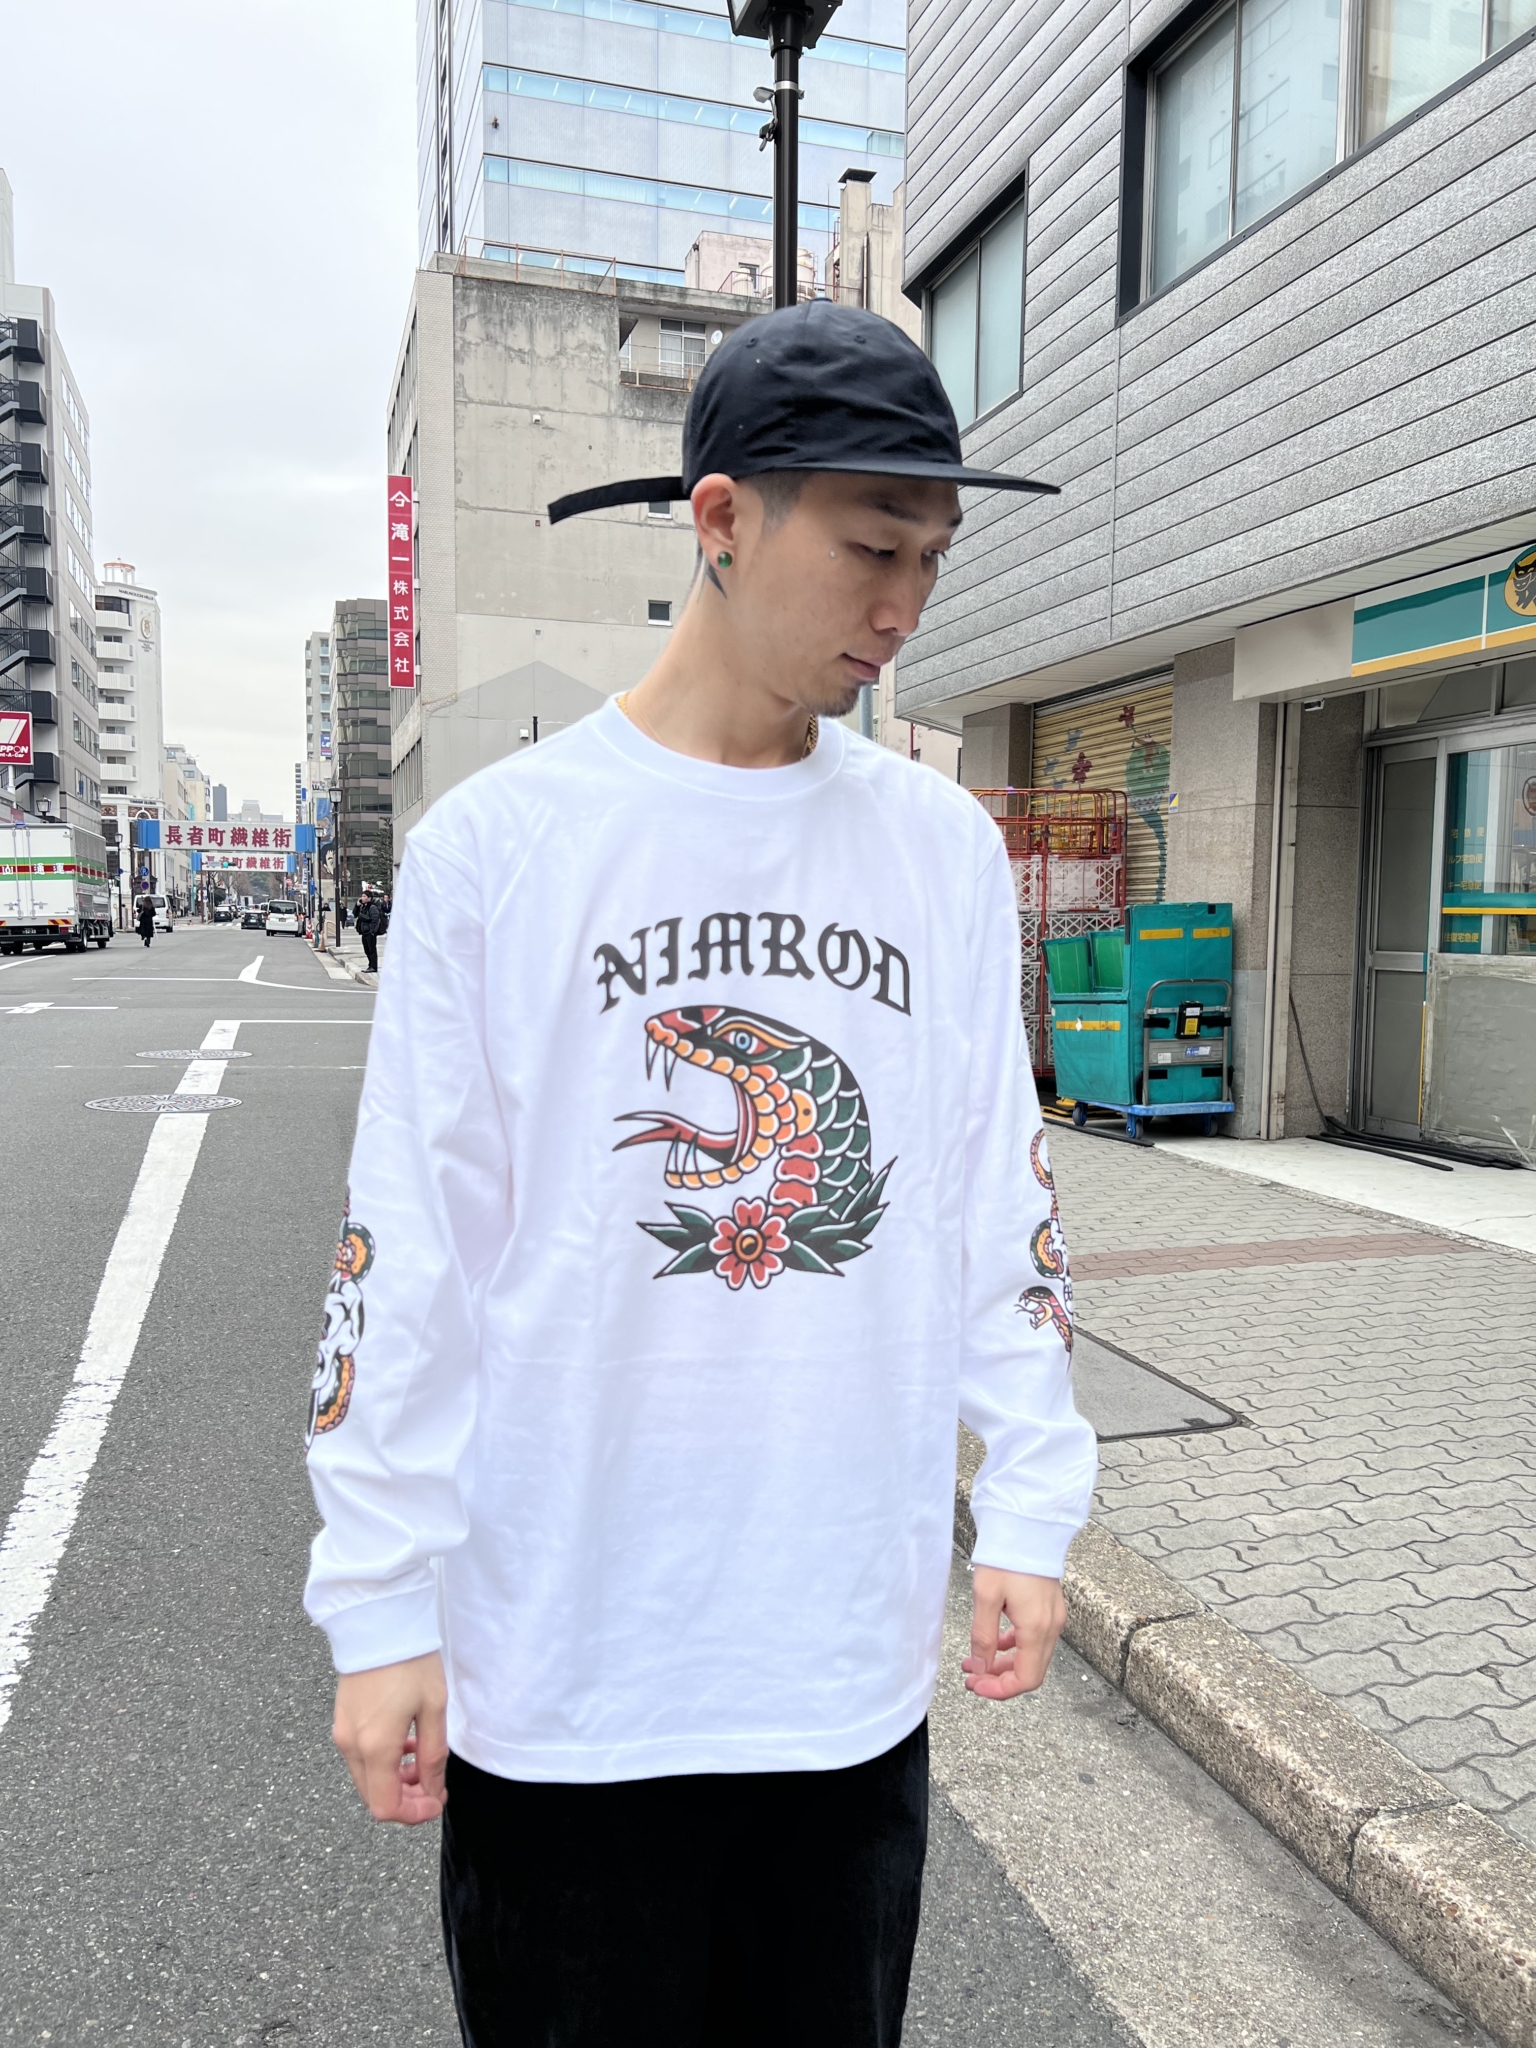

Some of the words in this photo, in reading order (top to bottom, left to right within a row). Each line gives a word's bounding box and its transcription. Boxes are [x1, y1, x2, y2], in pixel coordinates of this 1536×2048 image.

[0, 745, 29, 754] PPON
[165, 825, 292, 848] 長者町繊維街
[1448, 854, 1483, 864] ルフ宅急便
[594, 911, 911, 1017] NIMROD
